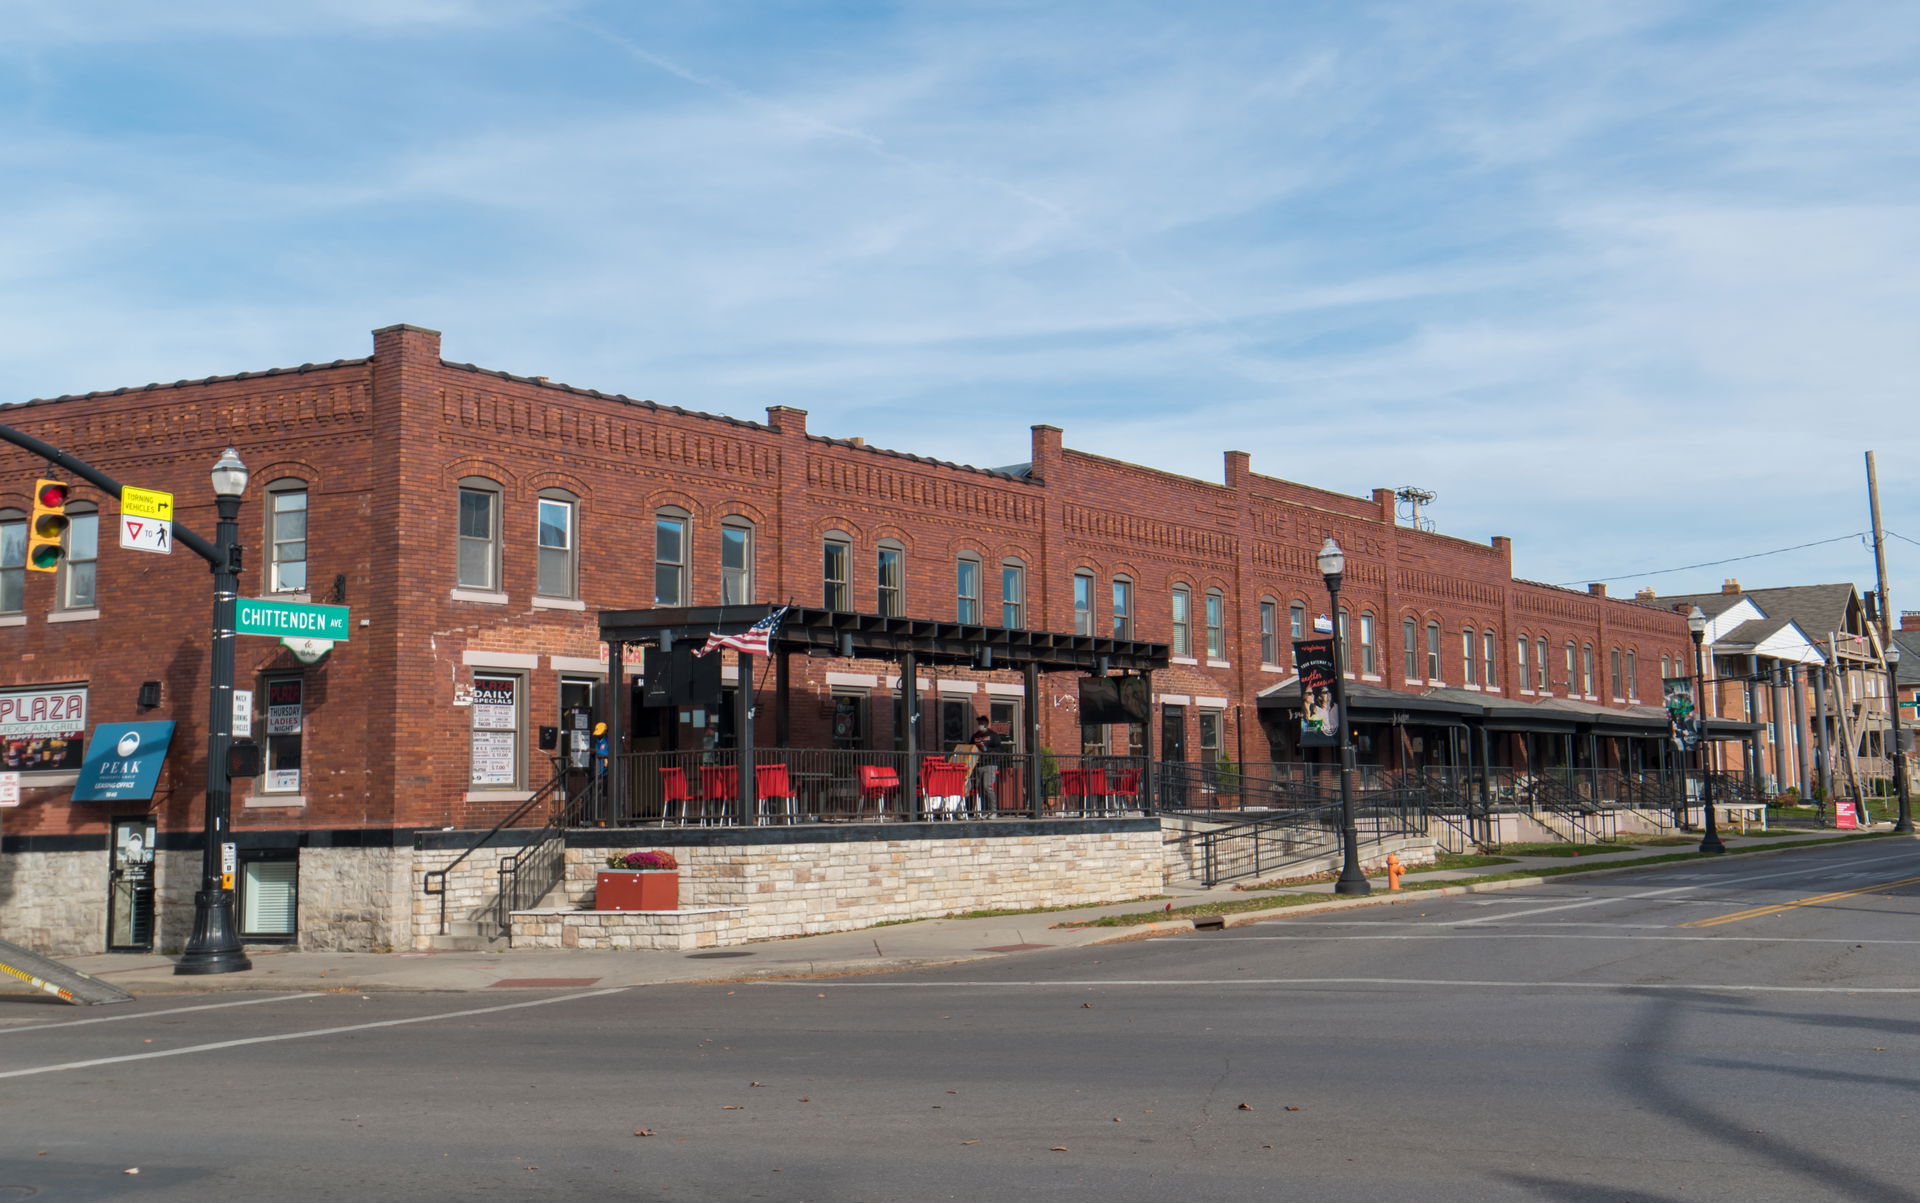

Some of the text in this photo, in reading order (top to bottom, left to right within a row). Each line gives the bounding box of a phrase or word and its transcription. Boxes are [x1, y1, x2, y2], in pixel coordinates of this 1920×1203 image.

[127, 493, 153, 504] TURNING
[126, 502, 155, 513] VEHICLES
[145, 529, 153, 538] TO
[241, 607, 343, 630] CHITTENDEN AVE
[474, 681, 513, 690] PLAZA
[271, 685, 300, 702] PLAZA
[474, 690, 512, 699] DAILY
[0, 695, 82, 723] PLAZA
[270, 706, 300, 717] THURSDAY
[51, 722, 80, 731] GRILL
[270, 717, 298, 725] LADIES
[100, 761, 142, 774] PEAK
[116, 781, 136, 789] OFFICE
